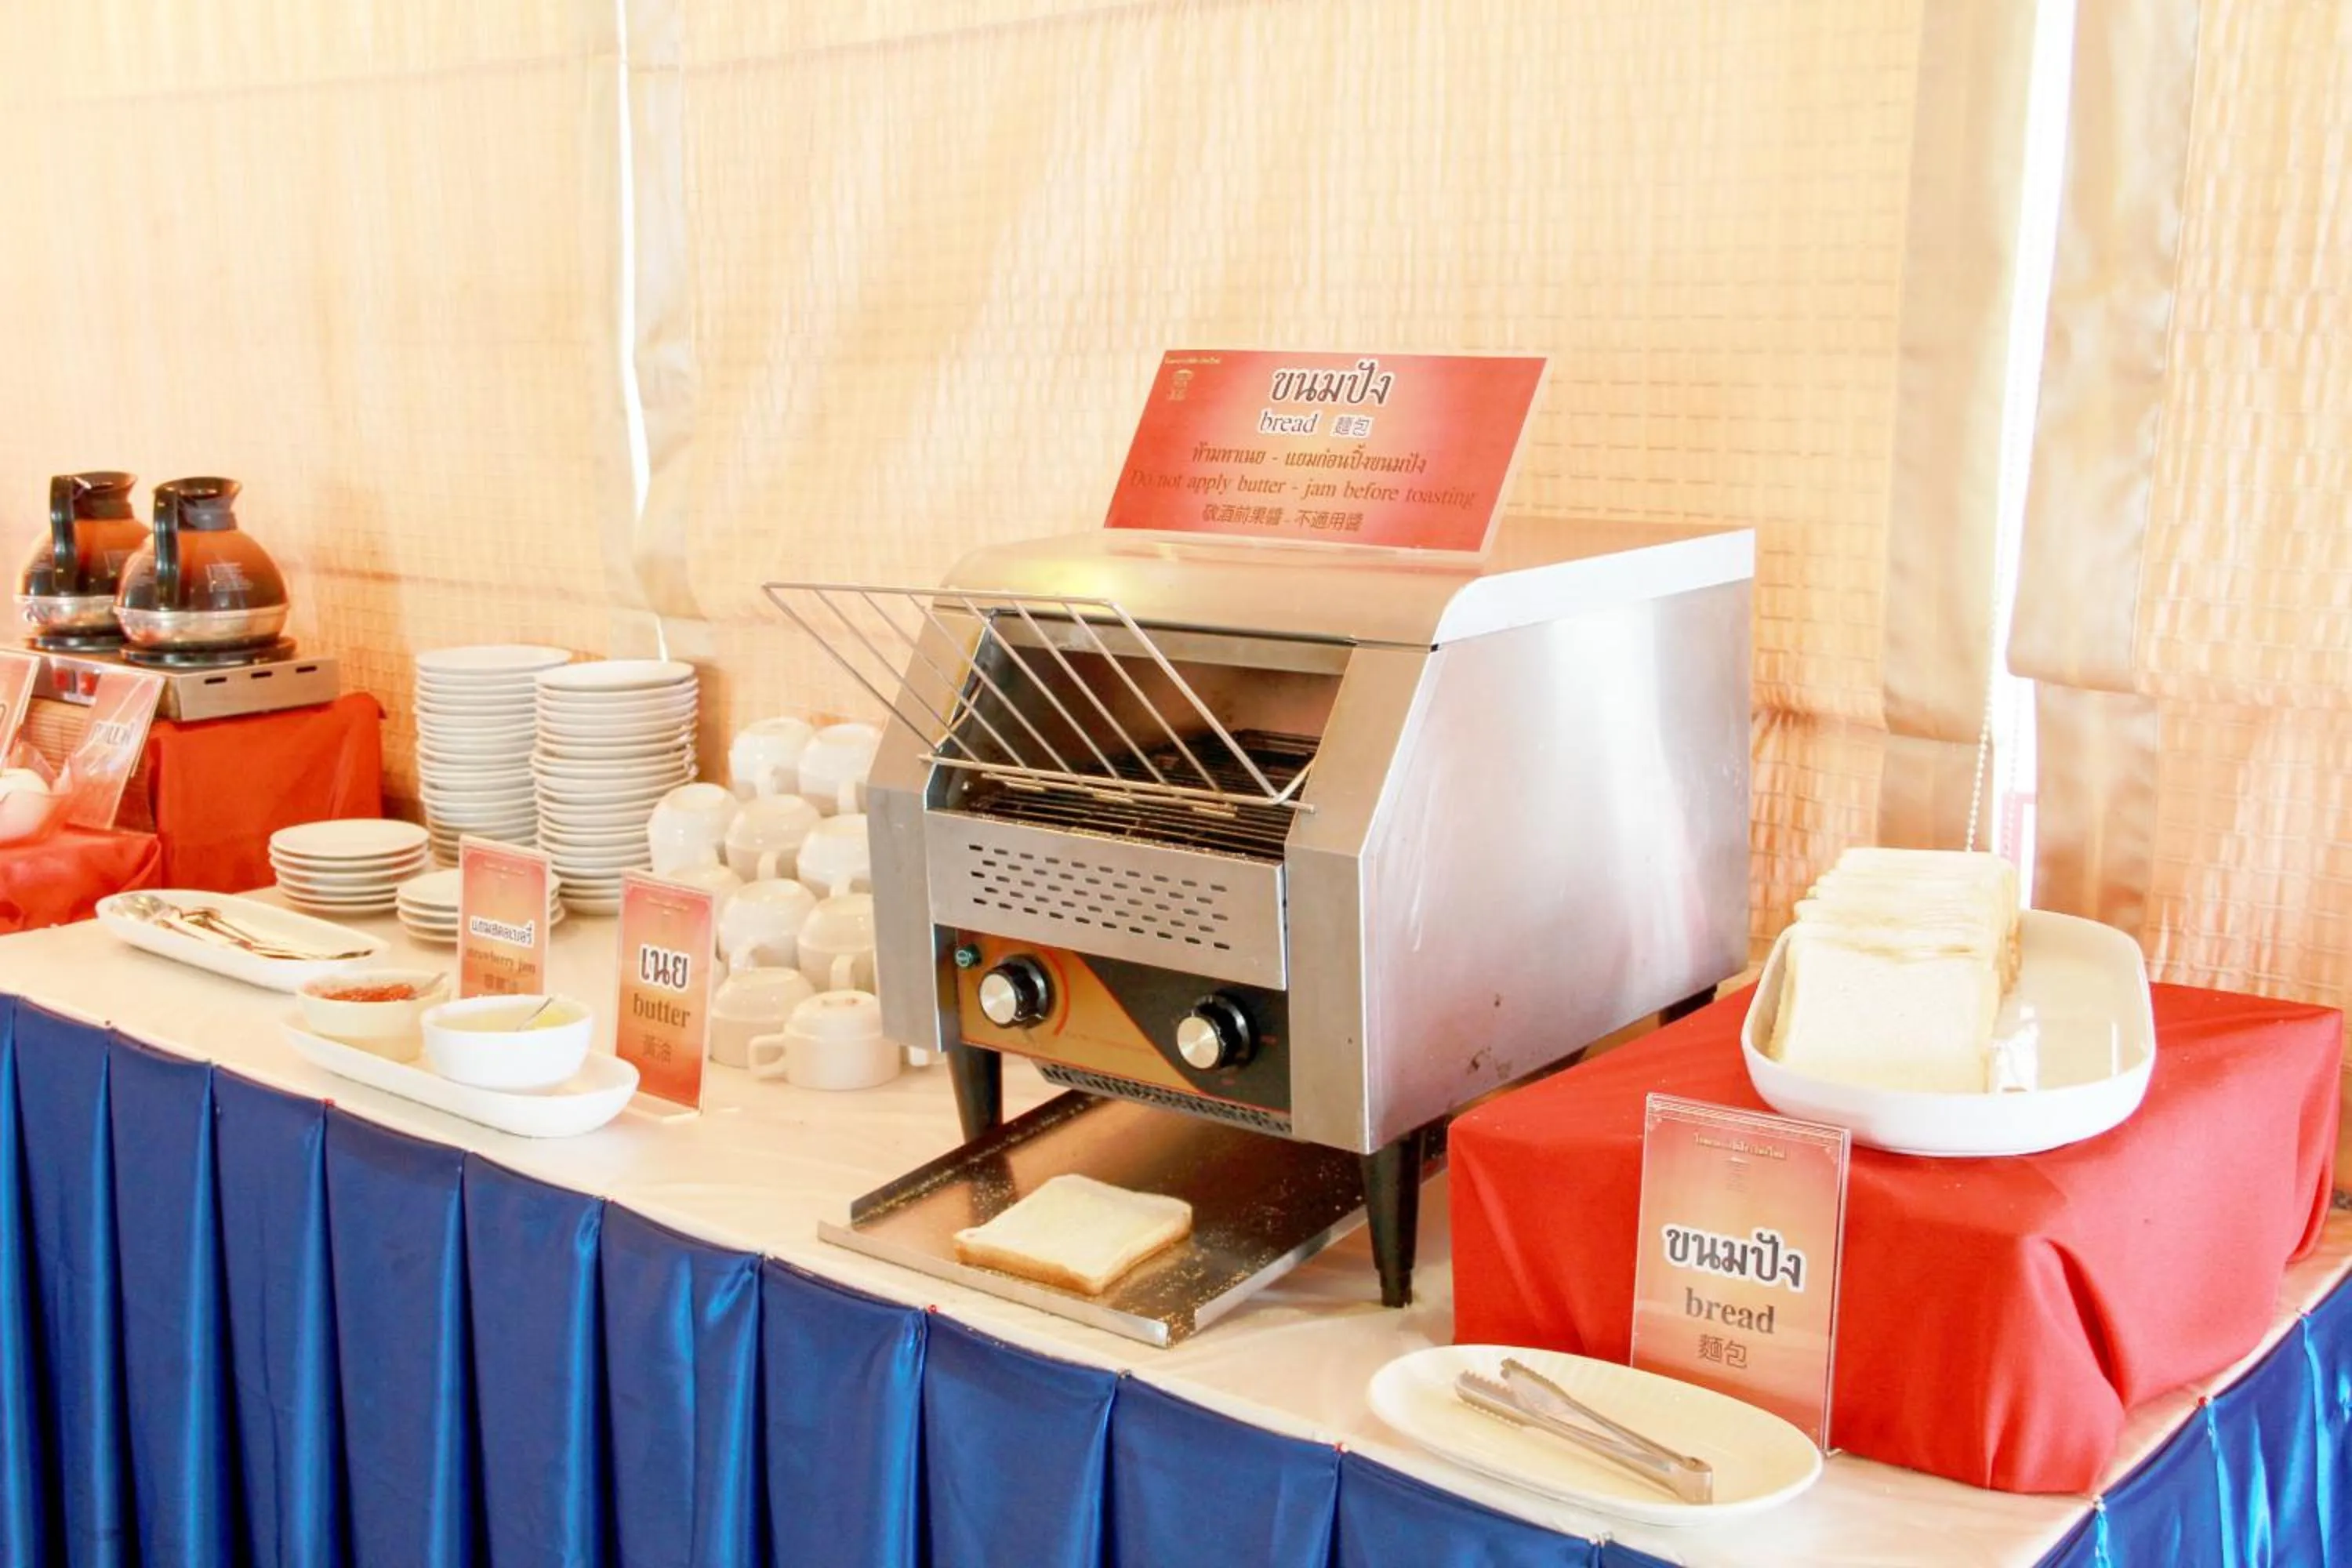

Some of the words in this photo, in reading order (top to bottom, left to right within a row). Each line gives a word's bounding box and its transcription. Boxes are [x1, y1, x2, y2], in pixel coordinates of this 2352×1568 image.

[1271, 361, 1392, 405] ขนมปัง
[1260, 410, 1319, 433] bread
[1157, 473, 1183, 489] not
[1186, 471, 1232, 495] apply
[1237, 474, 1287, 494] butter
[1300, 477, 1337, 500] jam
[1343, 481, 1399, 502] before
[1404, 487, 1476, 510] toasting
[641, 947, 688, 989] เนย
[633, 992, 691, 1029] butter
[1666, 1228, 1802, 1287] ขนมปัง
[1685, 1287, 1775, 1334] bread
[1697, 1334, 1748, 1370] 麵包
